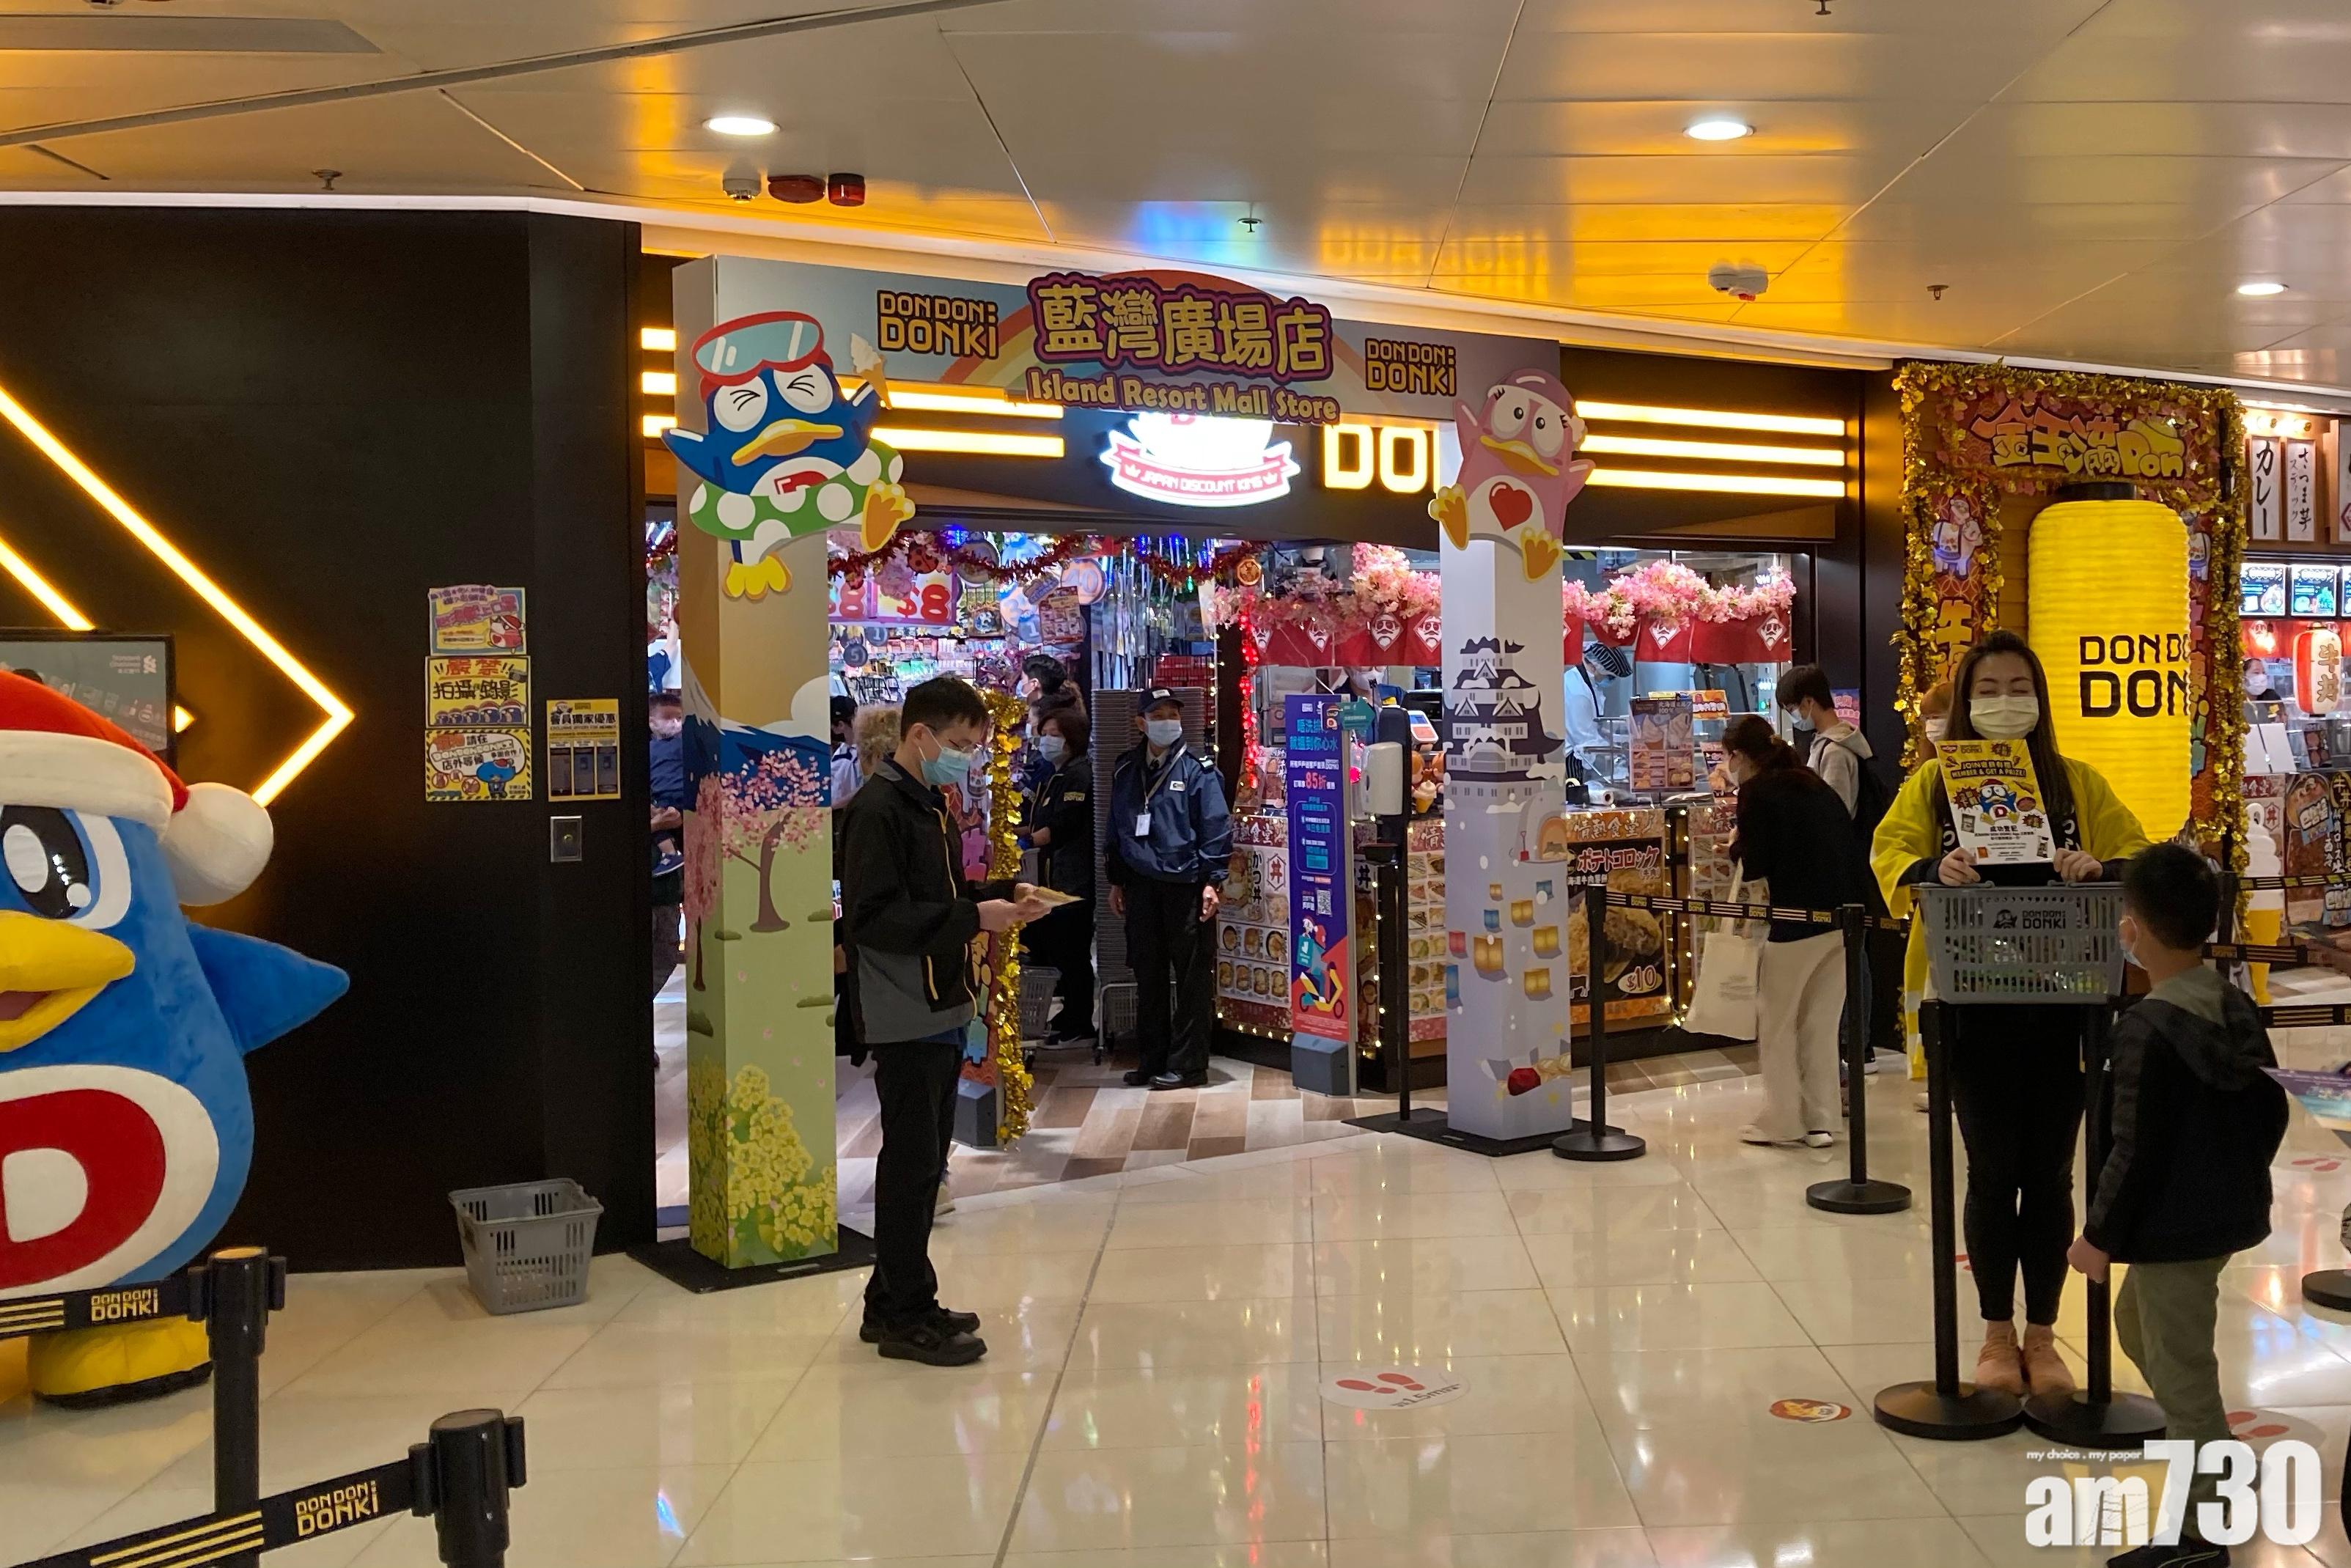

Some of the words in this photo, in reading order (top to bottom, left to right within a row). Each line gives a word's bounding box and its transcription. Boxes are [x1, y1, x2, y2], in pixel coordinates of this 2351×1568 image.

[880, 315, 996, 357] DONKI
[1037, 283, 1324, 375] 藍灣廣場店
[1031, 372, 1116, 405] Island
[1122, 378, 1207, 411] Resort
[1212, 385, 1270, 416] Mall
[1276, 391, 1337, 420] Store
[1367, 360, 1455, 394] DONKI
[1324, 424, 1441, 494] DO
[1141, 471, 1179, 490] JAPAN
[1180, 478, 1236, 493] DISCOUNT
[1237, 475, 1263, 491] KING
[2256, 441, 2274, 536] カレー
[1577, 845, 1660, 873] ポテトコロッケ
[2023, 918, 2066, 929] DONKI
[1626, 965, 1658, 991] $10
[92, 1297, 158, 1322] DONKI
[297, 1492, 378, 1537] DONKI
